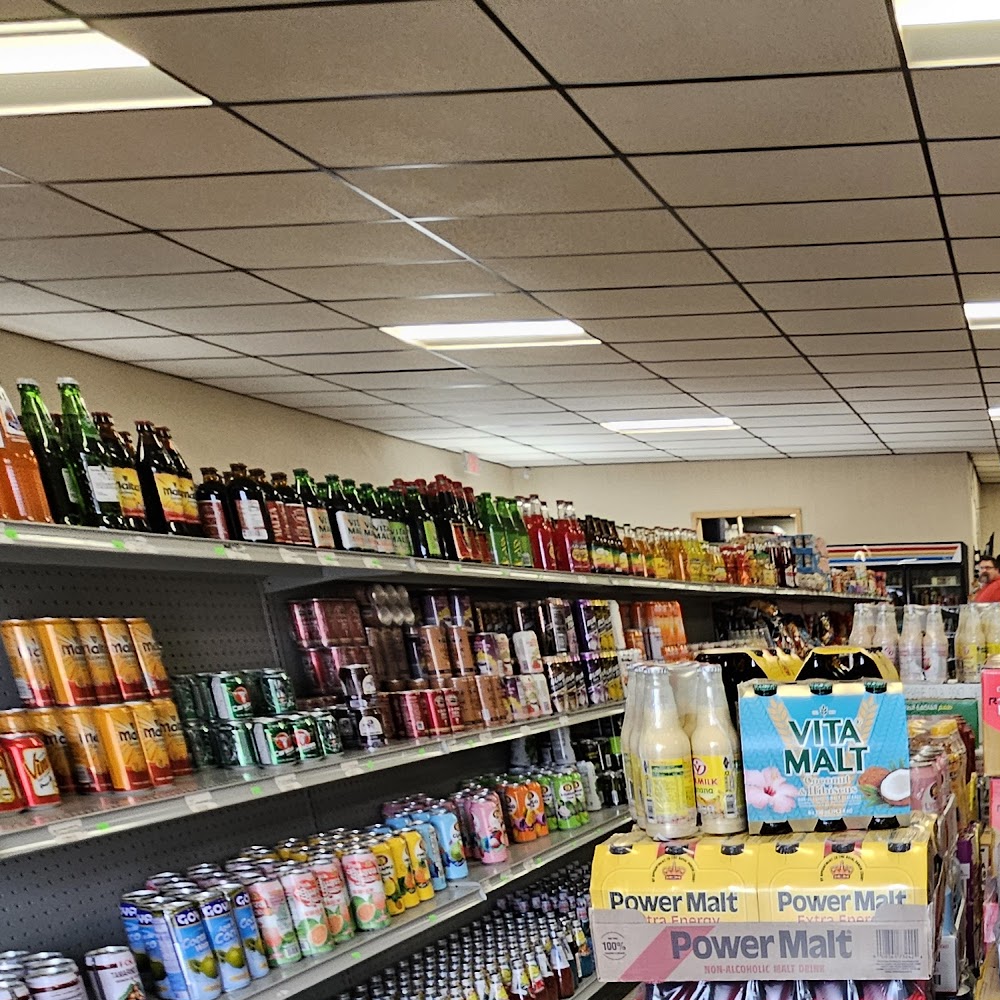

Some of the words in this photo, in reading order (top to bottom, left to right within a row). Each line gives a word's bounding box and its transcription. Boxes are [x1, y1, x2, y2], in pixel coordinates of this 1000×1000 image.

[788, 719, 862, 746] VITA
[784, 746, 868, 774] MALT
[609, 892, 683, 912] Power
[686, 892, 738, 912] Malt
[777, 892, 851, 912] Power
[602, 941, 627, 951] 100%
[670, 931, 775, 959] Power
[779, 930, 852, 959] Malt
[704, 965, 771, 974] NON-ALCOHOLIC
[773, 964, 795, 973] MALT
[798, 964, 825, 973] DRINK
